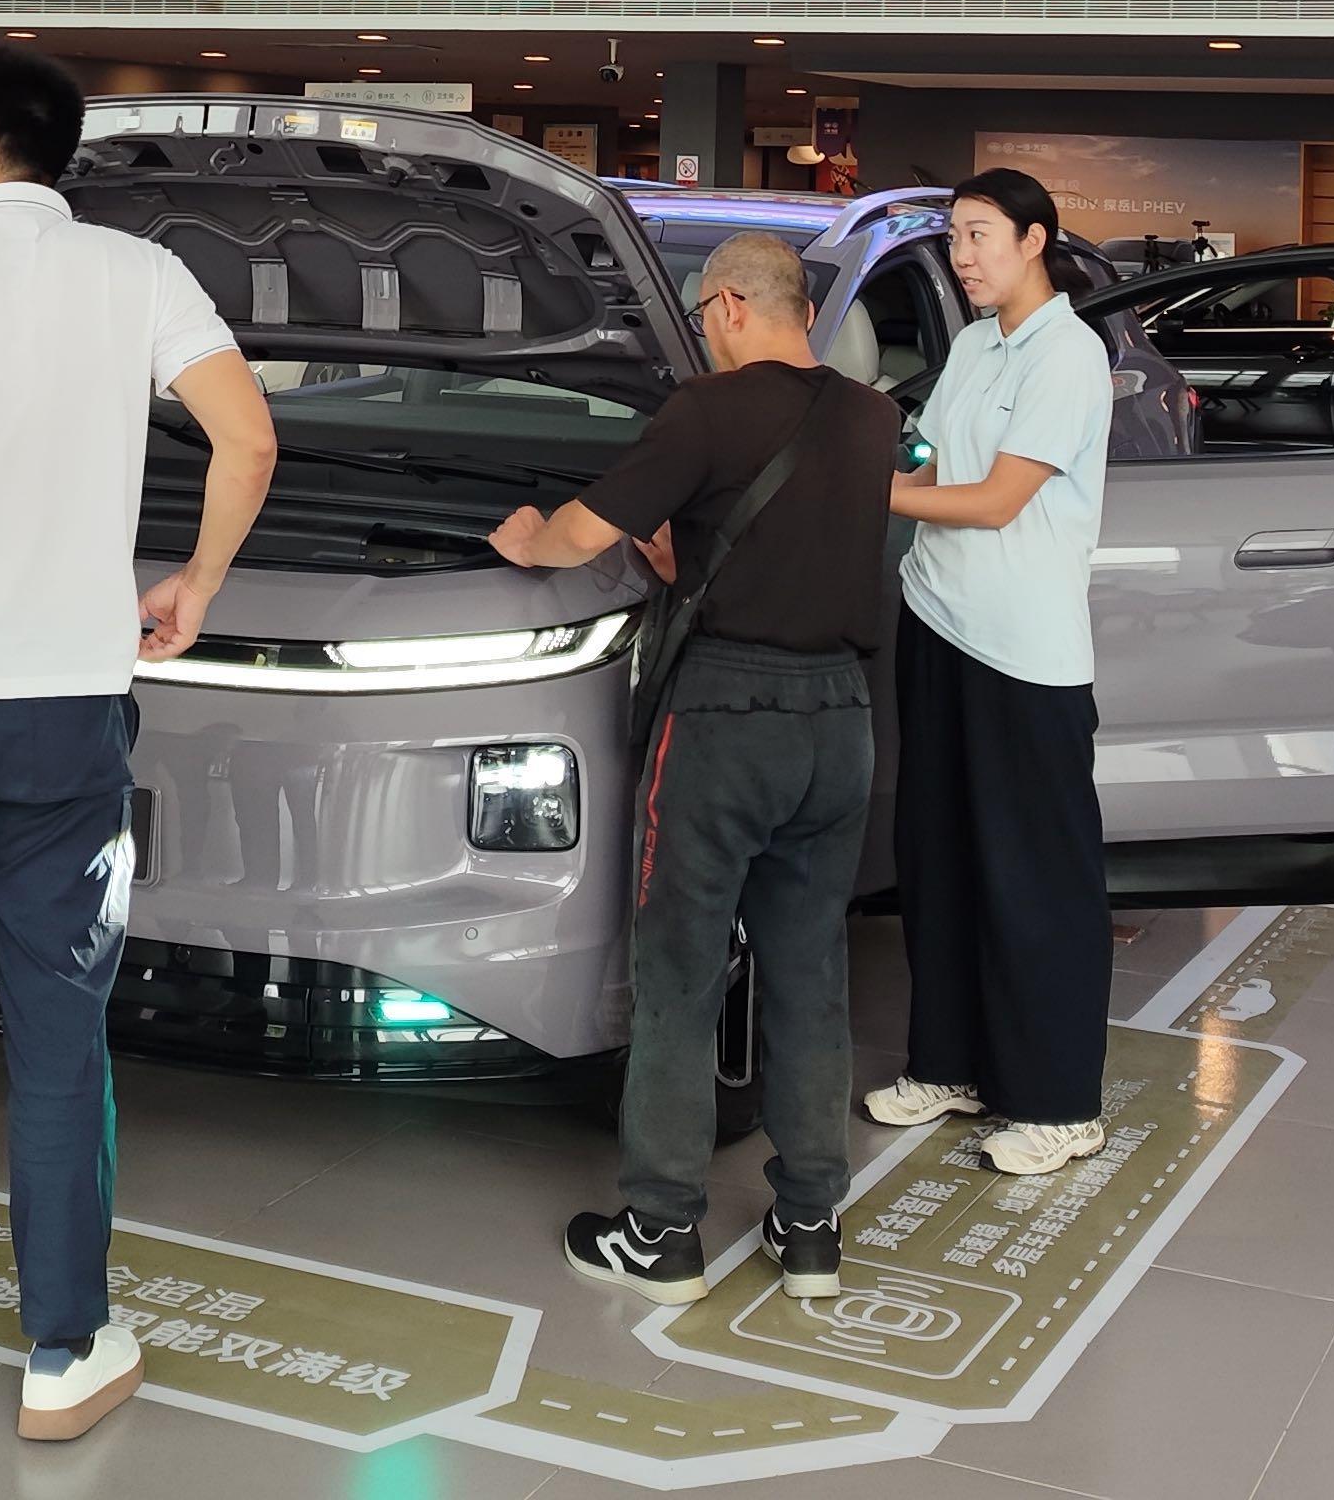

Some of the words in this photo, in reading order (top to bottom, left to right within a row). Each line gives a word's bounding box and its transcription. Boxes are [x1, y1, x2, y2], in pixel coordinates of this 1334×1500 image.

[1143, 201, 1186, 215] PHEV
[8, 1265, 266, 1322] 金超混
